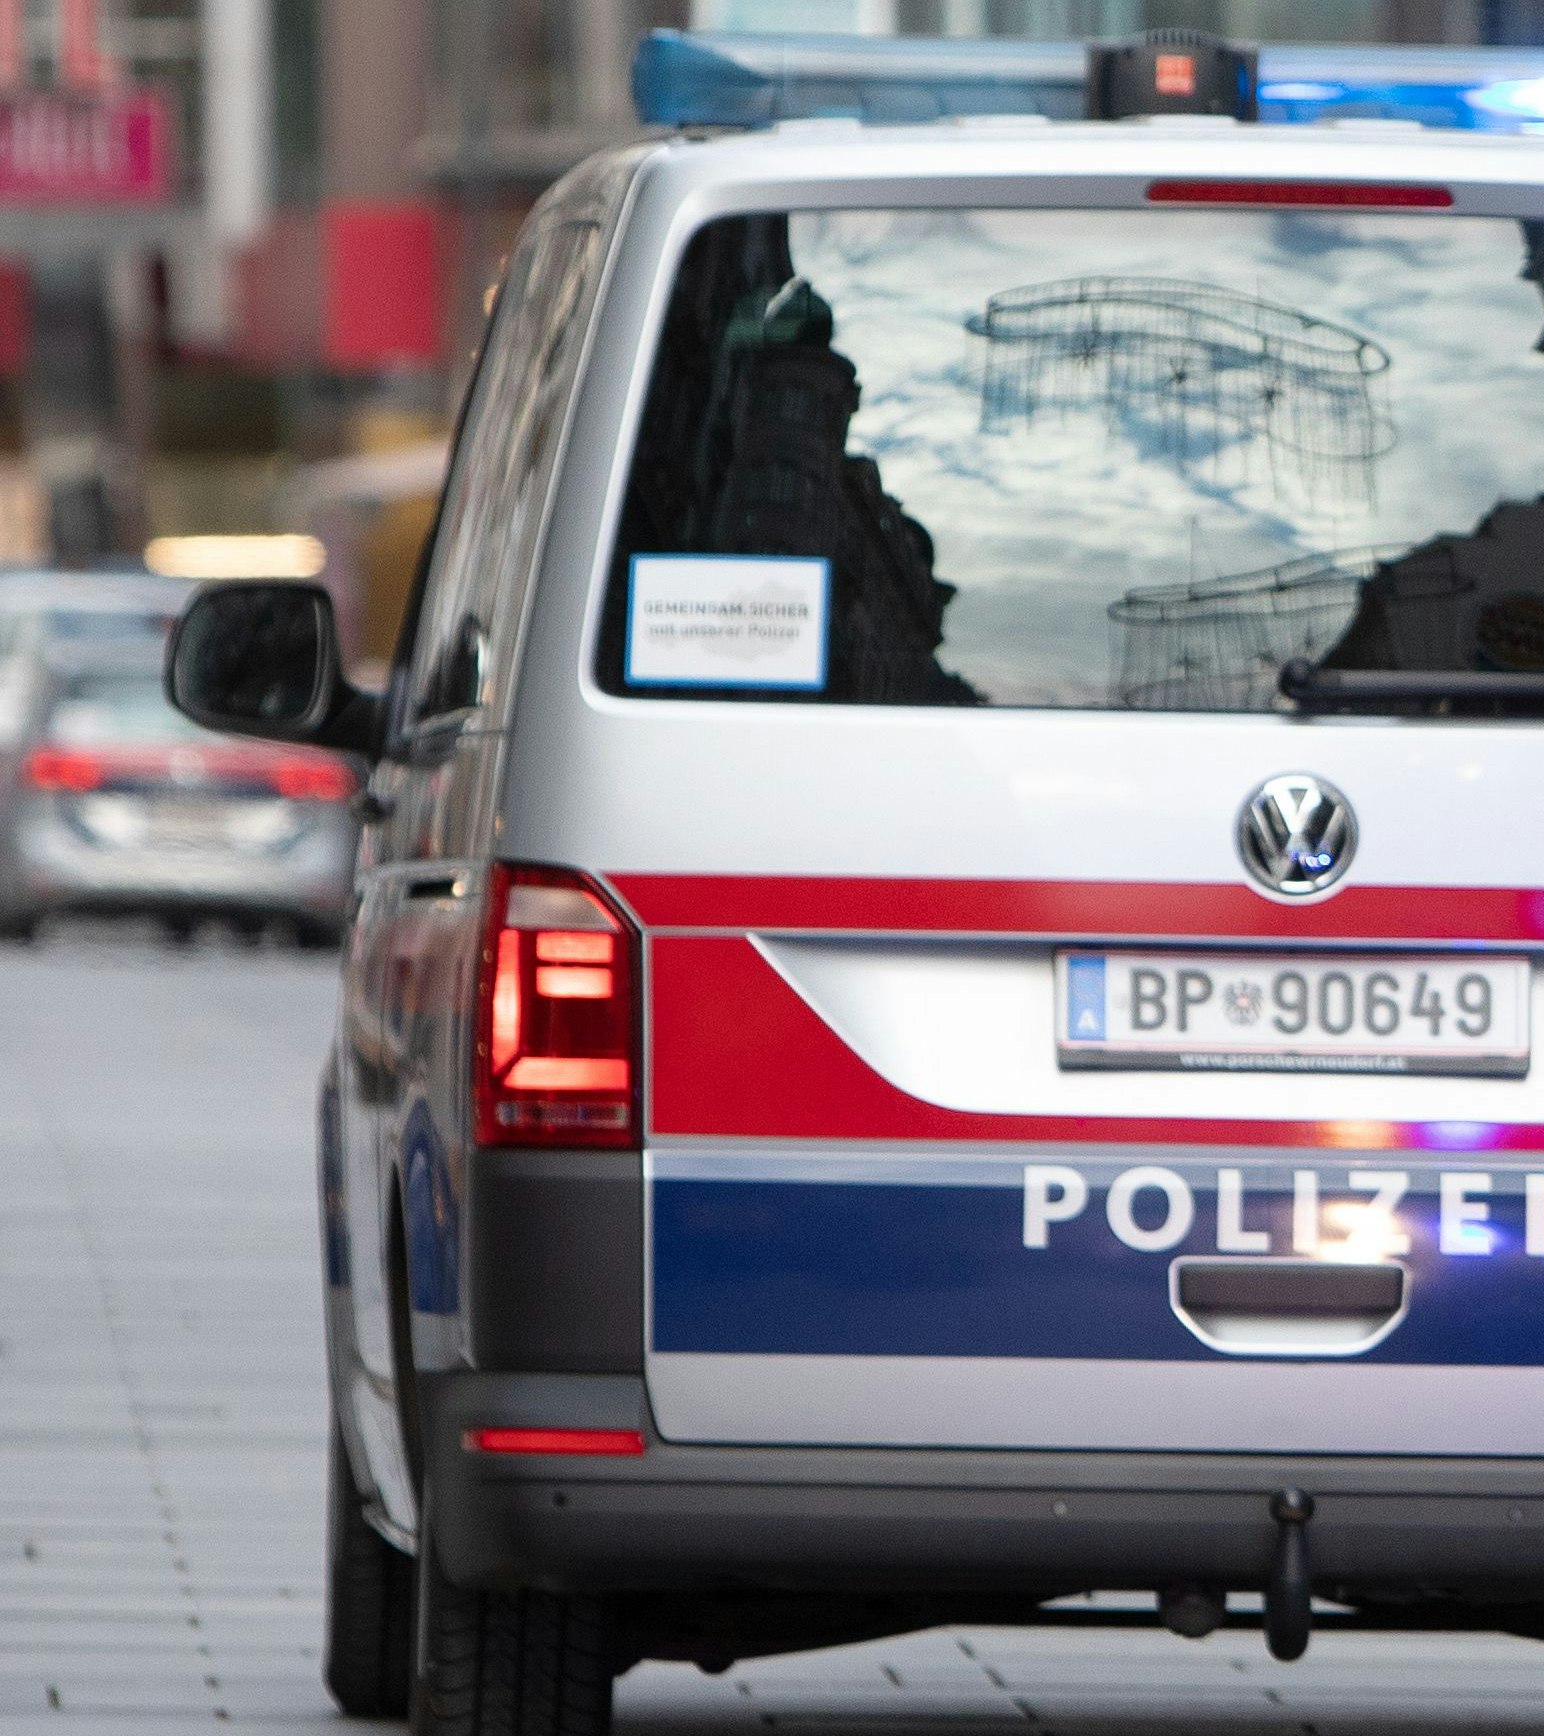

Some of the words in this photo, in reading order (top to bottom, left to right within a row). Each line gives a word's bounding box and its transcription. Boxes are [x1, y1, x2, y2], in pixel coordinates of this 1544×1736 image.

[648, 623, 675, 636] mit
[680, 624, 742, 638] unserer
[748, 624, 801, 639] Polizei
[1076, 1009, 1098, 1031] A
[1129, 967, 1213, 1032] BP
[1271, 970, 1493, 1037] 90649
